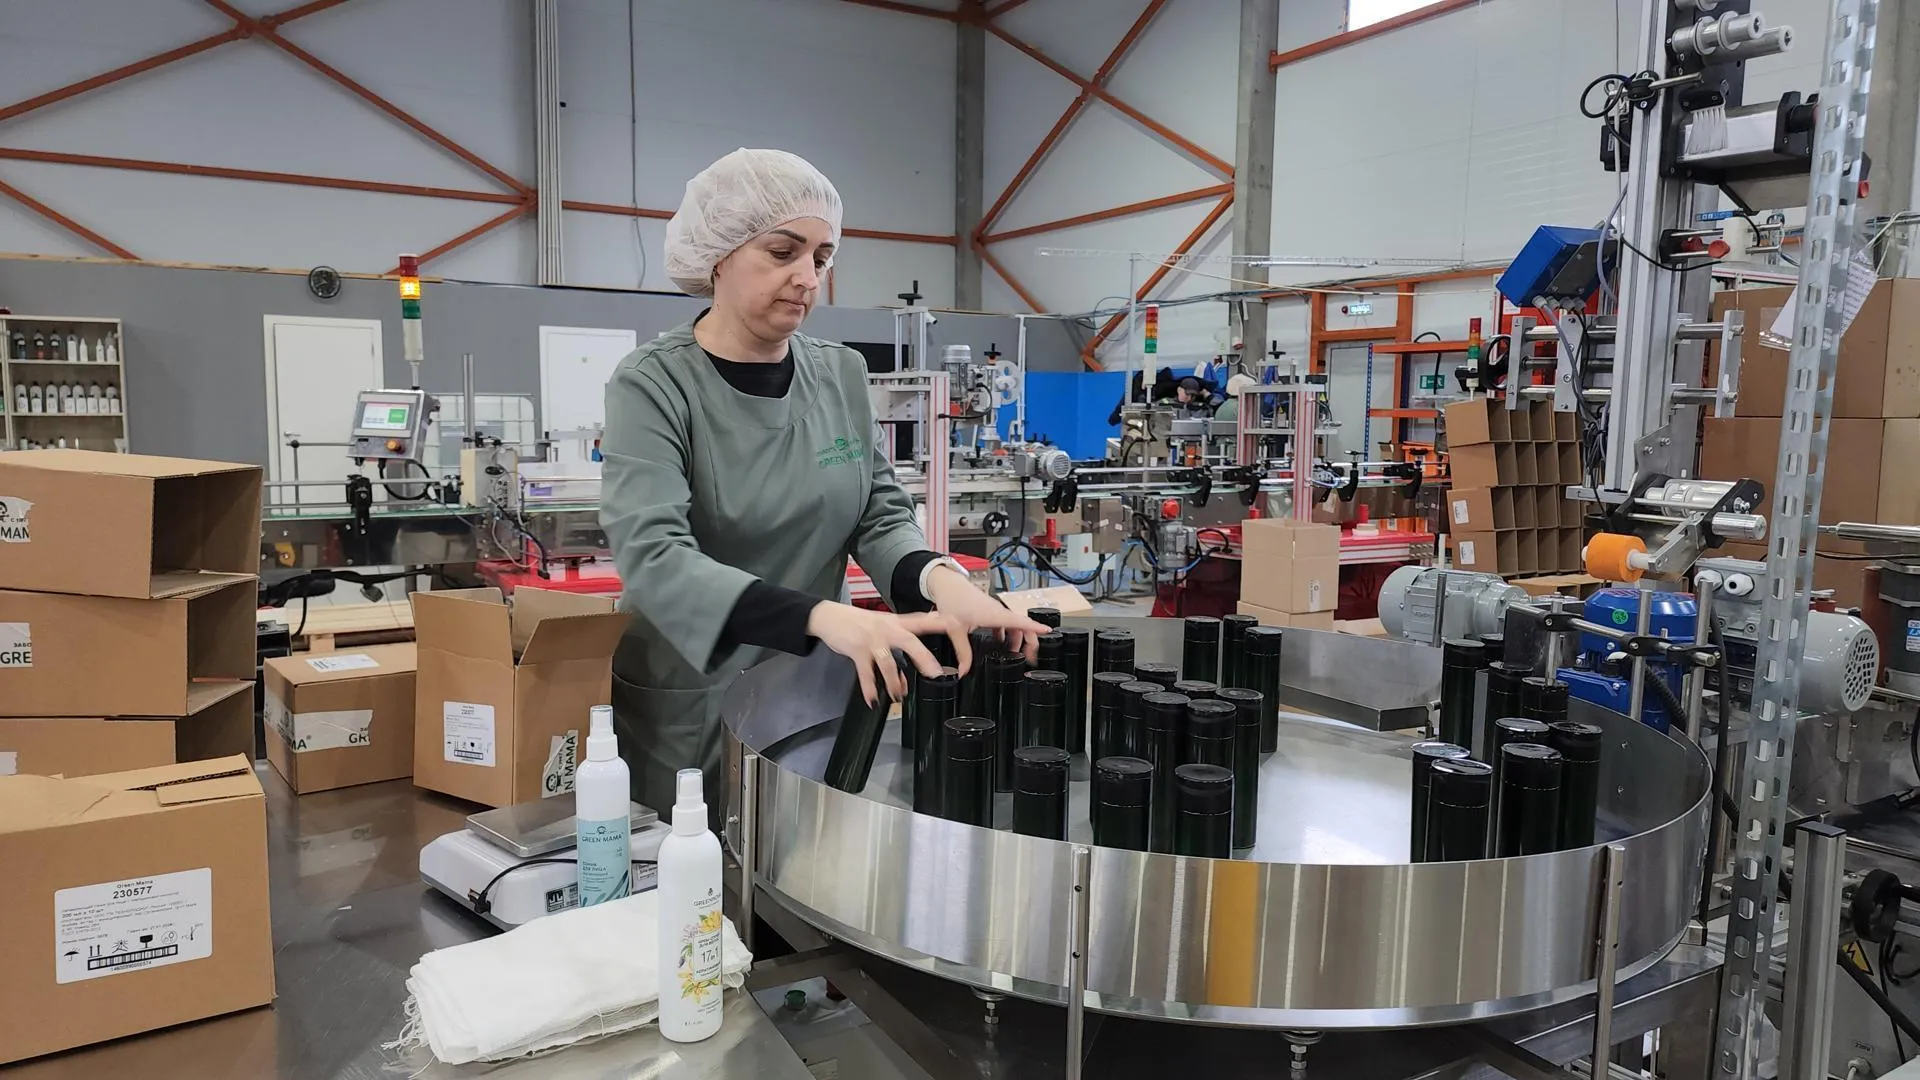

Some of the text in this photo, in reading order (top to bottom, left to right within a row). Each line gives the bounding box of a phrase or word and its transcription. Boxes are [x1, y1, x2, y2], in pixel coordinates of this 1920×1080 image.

[0, 652, 32, 664] GRE
[348, 732, 370, 744] GR
[565, 736, 576, 776] MAMA
[113, 886, 153, 899] 230577
